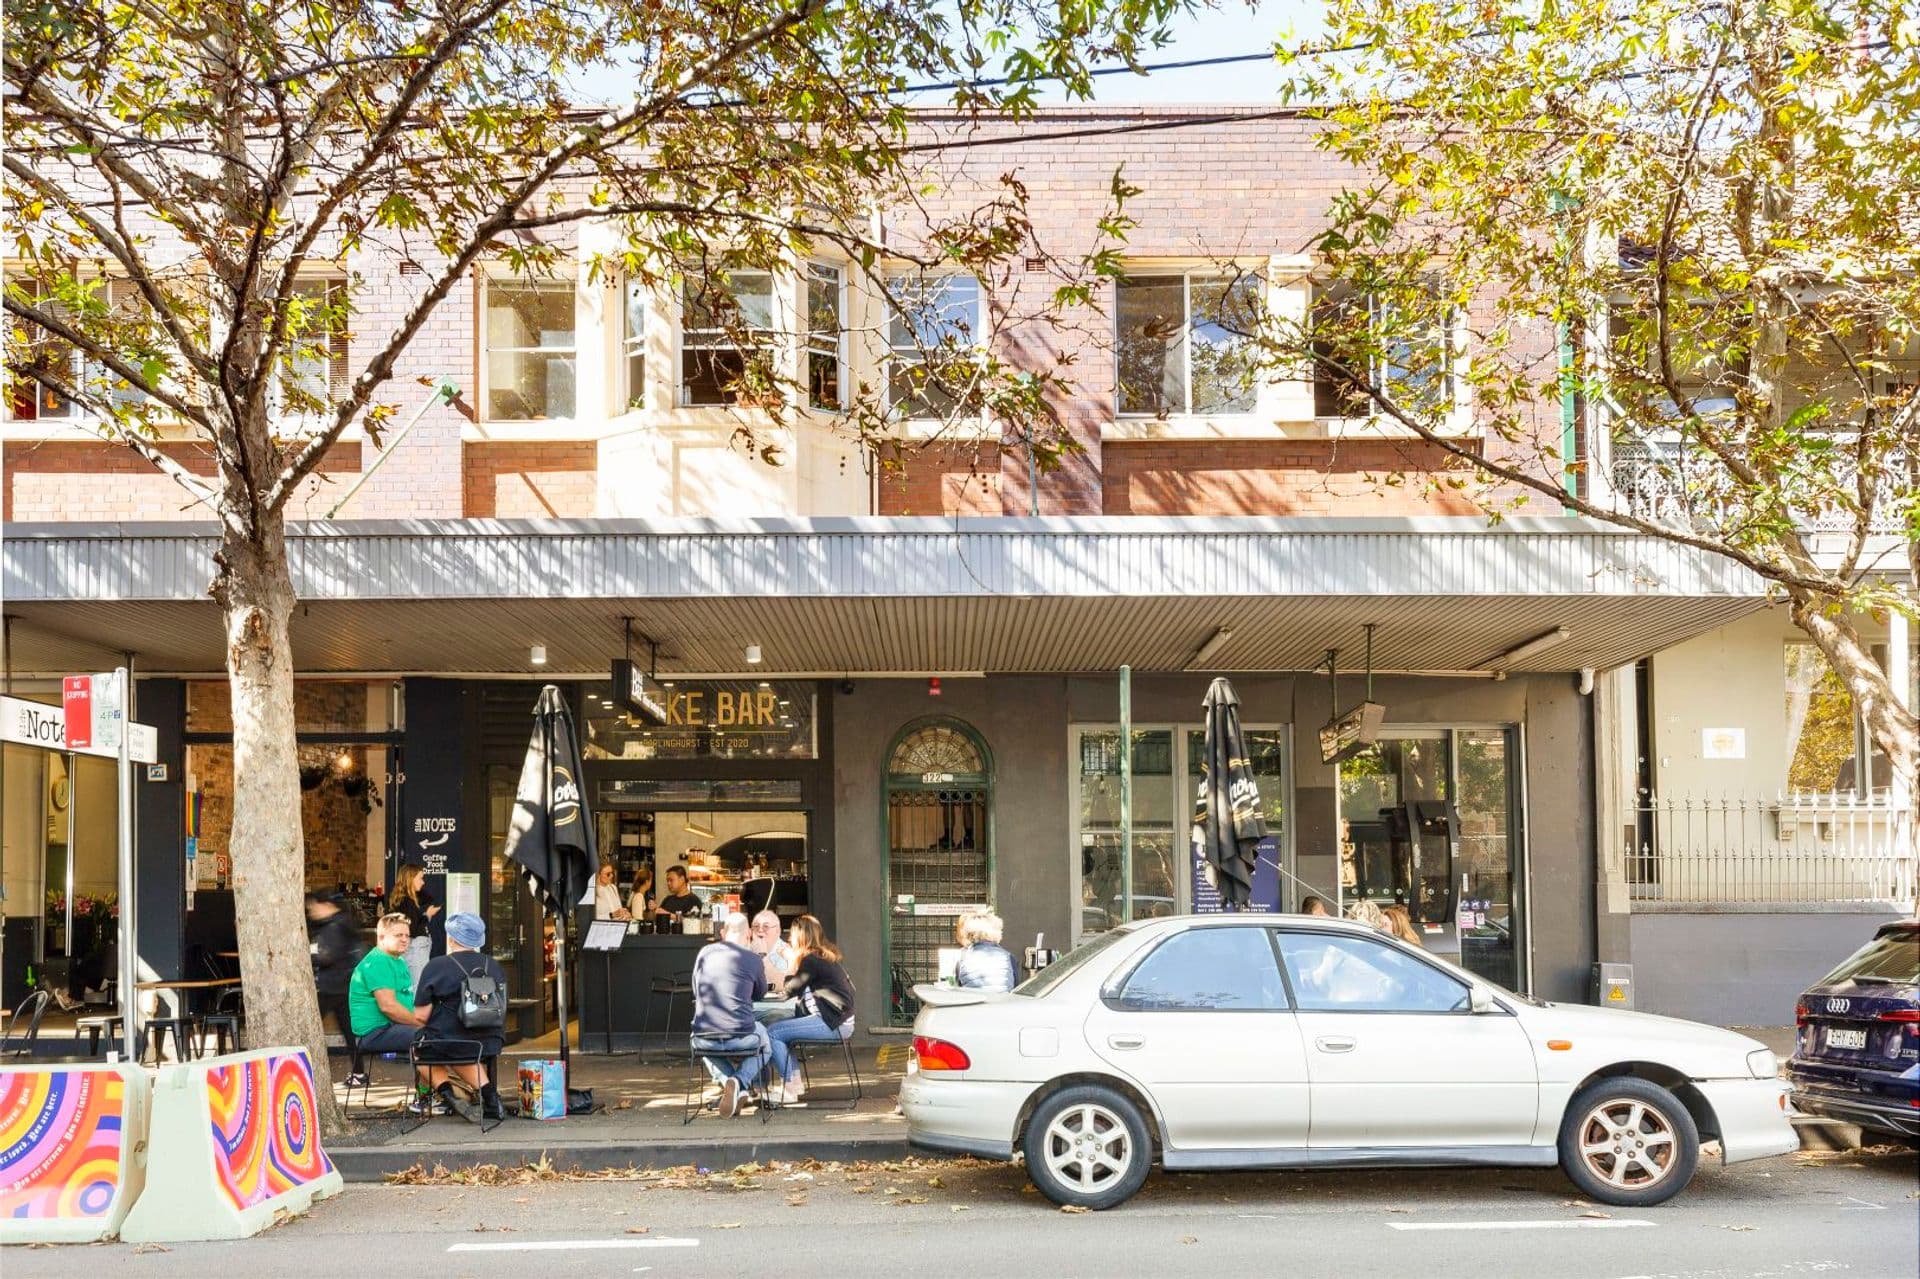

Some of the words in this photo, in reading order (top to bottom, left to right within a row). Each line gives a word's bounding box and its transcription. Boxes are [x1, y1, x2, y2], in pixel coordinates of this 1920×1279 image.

[717, 692, 775, 725] BAR
[727, 738, 749, 748] 2020
[421, 818, 456, 832] NOTE
